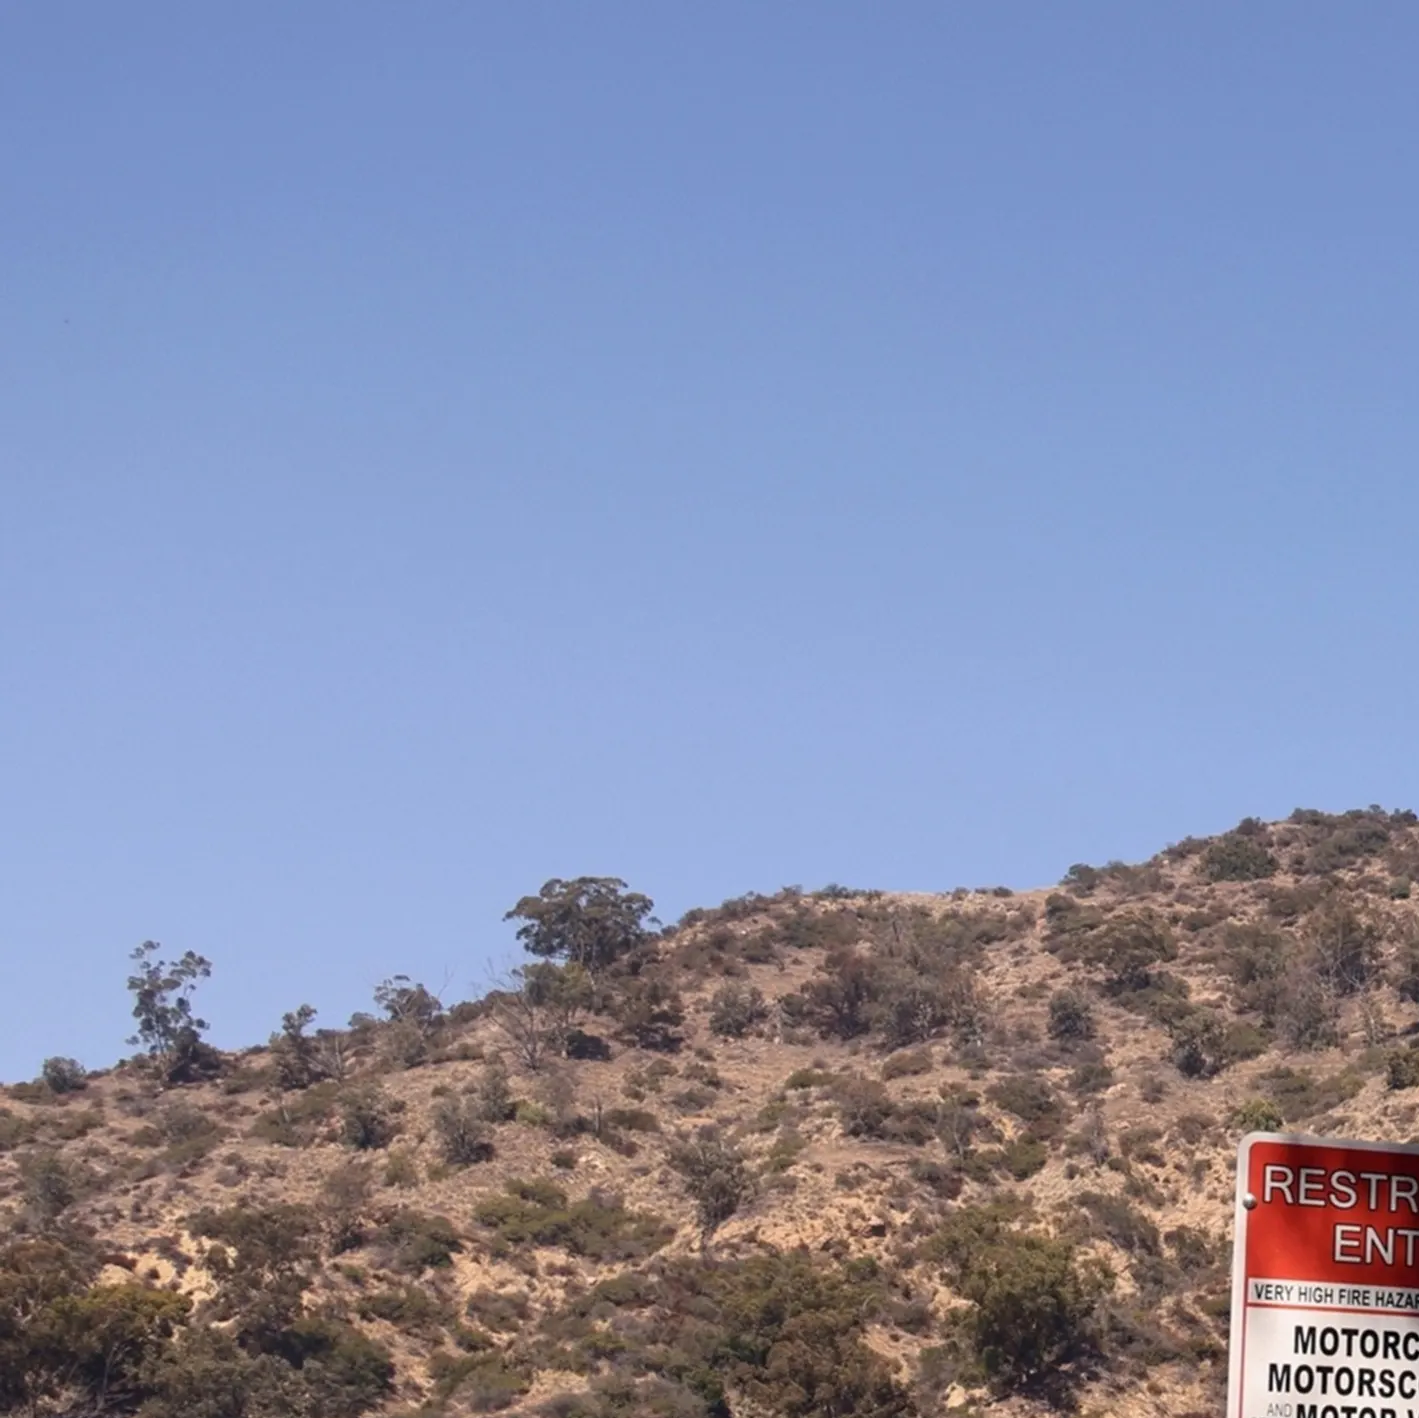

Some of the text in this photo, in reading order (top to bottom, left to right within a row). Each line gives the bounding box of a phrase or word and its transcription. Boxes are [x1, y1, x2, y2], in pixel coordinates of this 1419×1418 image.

[1254, 1284, 1293, 1300] VERY
[1298, 1286, 1333, 1303] HIGH
[1338, 1288, 1371, 1306] FIRE
[1267, 1402, 1292, 1417] AND
